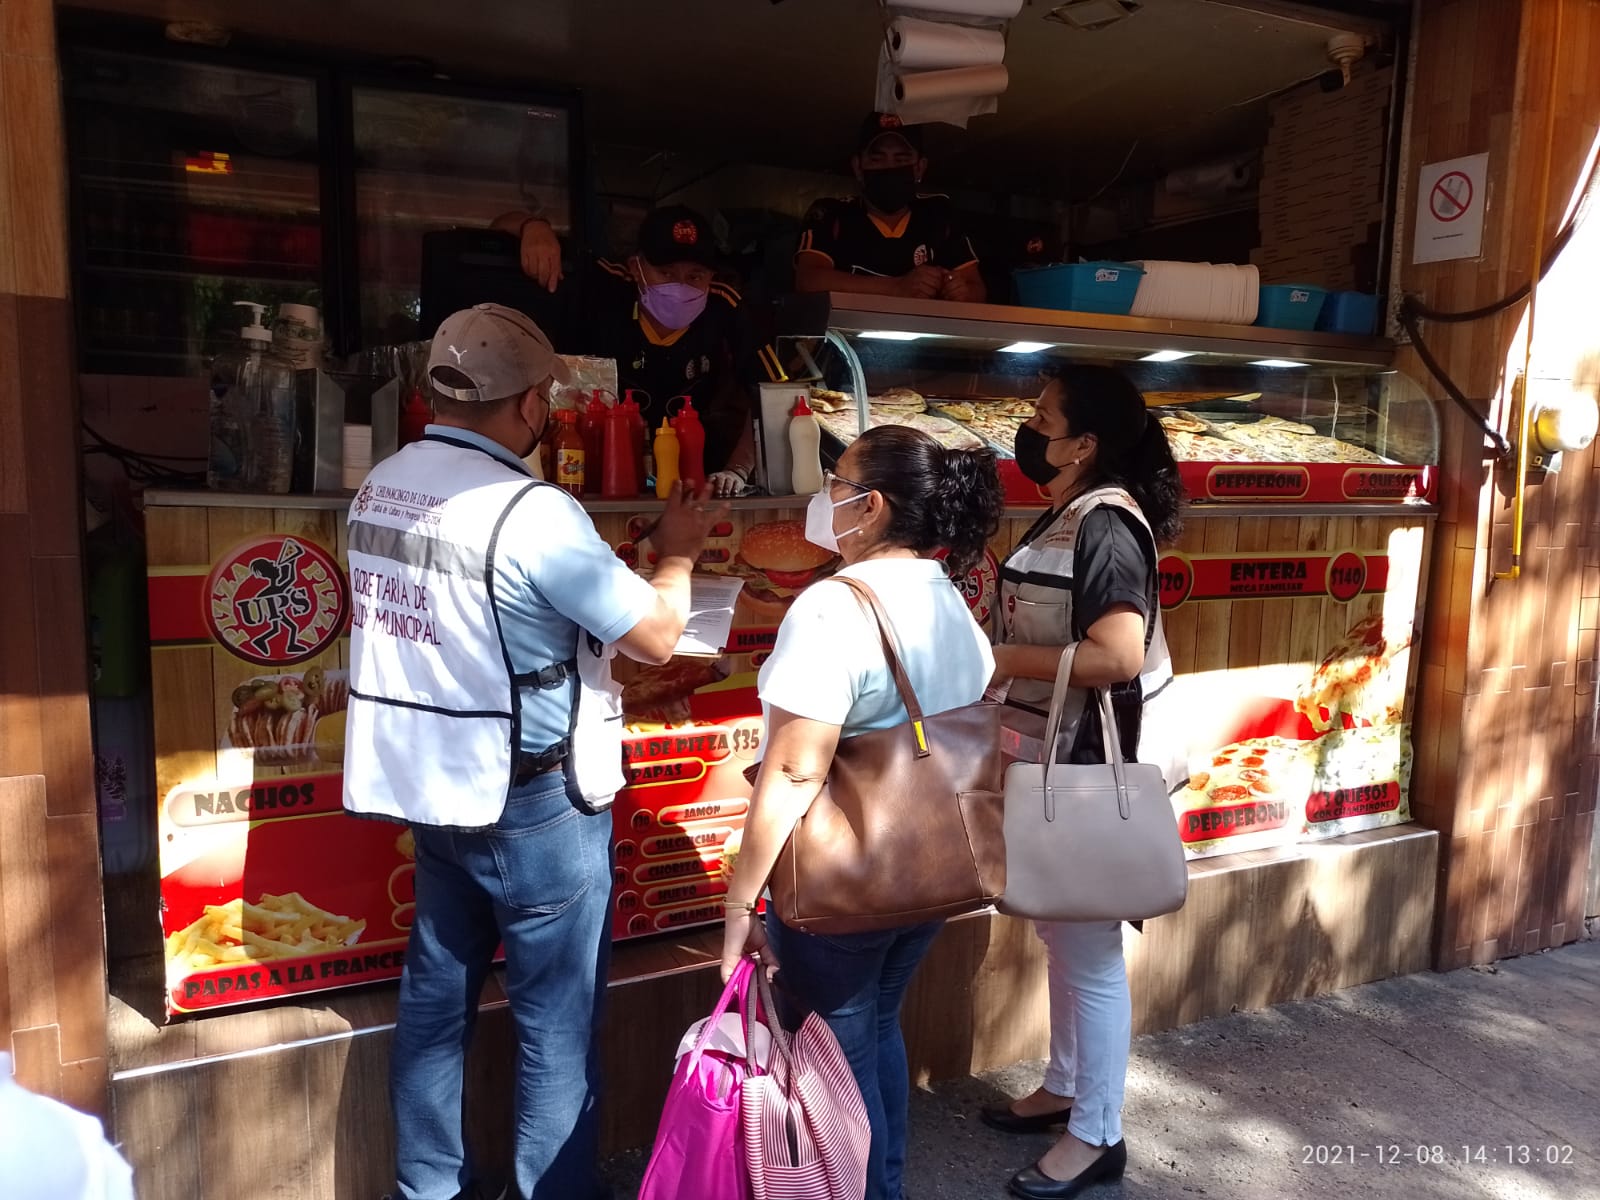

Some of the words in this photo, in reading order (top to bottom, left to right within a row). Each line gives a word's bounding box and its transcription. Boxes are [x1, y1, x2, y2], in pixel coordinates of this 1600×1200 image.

[1215, 473, 1302, 489] PEPPERONI
[1230, 561, 1307, 582] ENTERA
[1330, 567, 1361, 587] $140
[414, 585, 428, 611] DE
[1230, 583, 1257, 593] MEGA
[1258, 582, 1304, 593] FAMILIAR
[298, 561, 338, 645] PIZZA
[373, 607, 441, 645] MUNICIPAL
[649, 738, 672, 757] DE
[676, 733, 729, 753] PIZZA
[732, 728, 760, 753] $35
[194, 783, 315, 817] NACHOS
[1334, 783, 1388, 807] QUESOS
[1188, 800, 1287, 834] PEPPERONI
[648, 859, 699, 876] CHORIZO
[658, 885, 696, 900] HUEVO
[184, 971, 261, 999] PAPAS
[268, 968, 283, 986] A
[288, 963, 316, 984] LA
[320, 950, 407, 979] FRANCE
